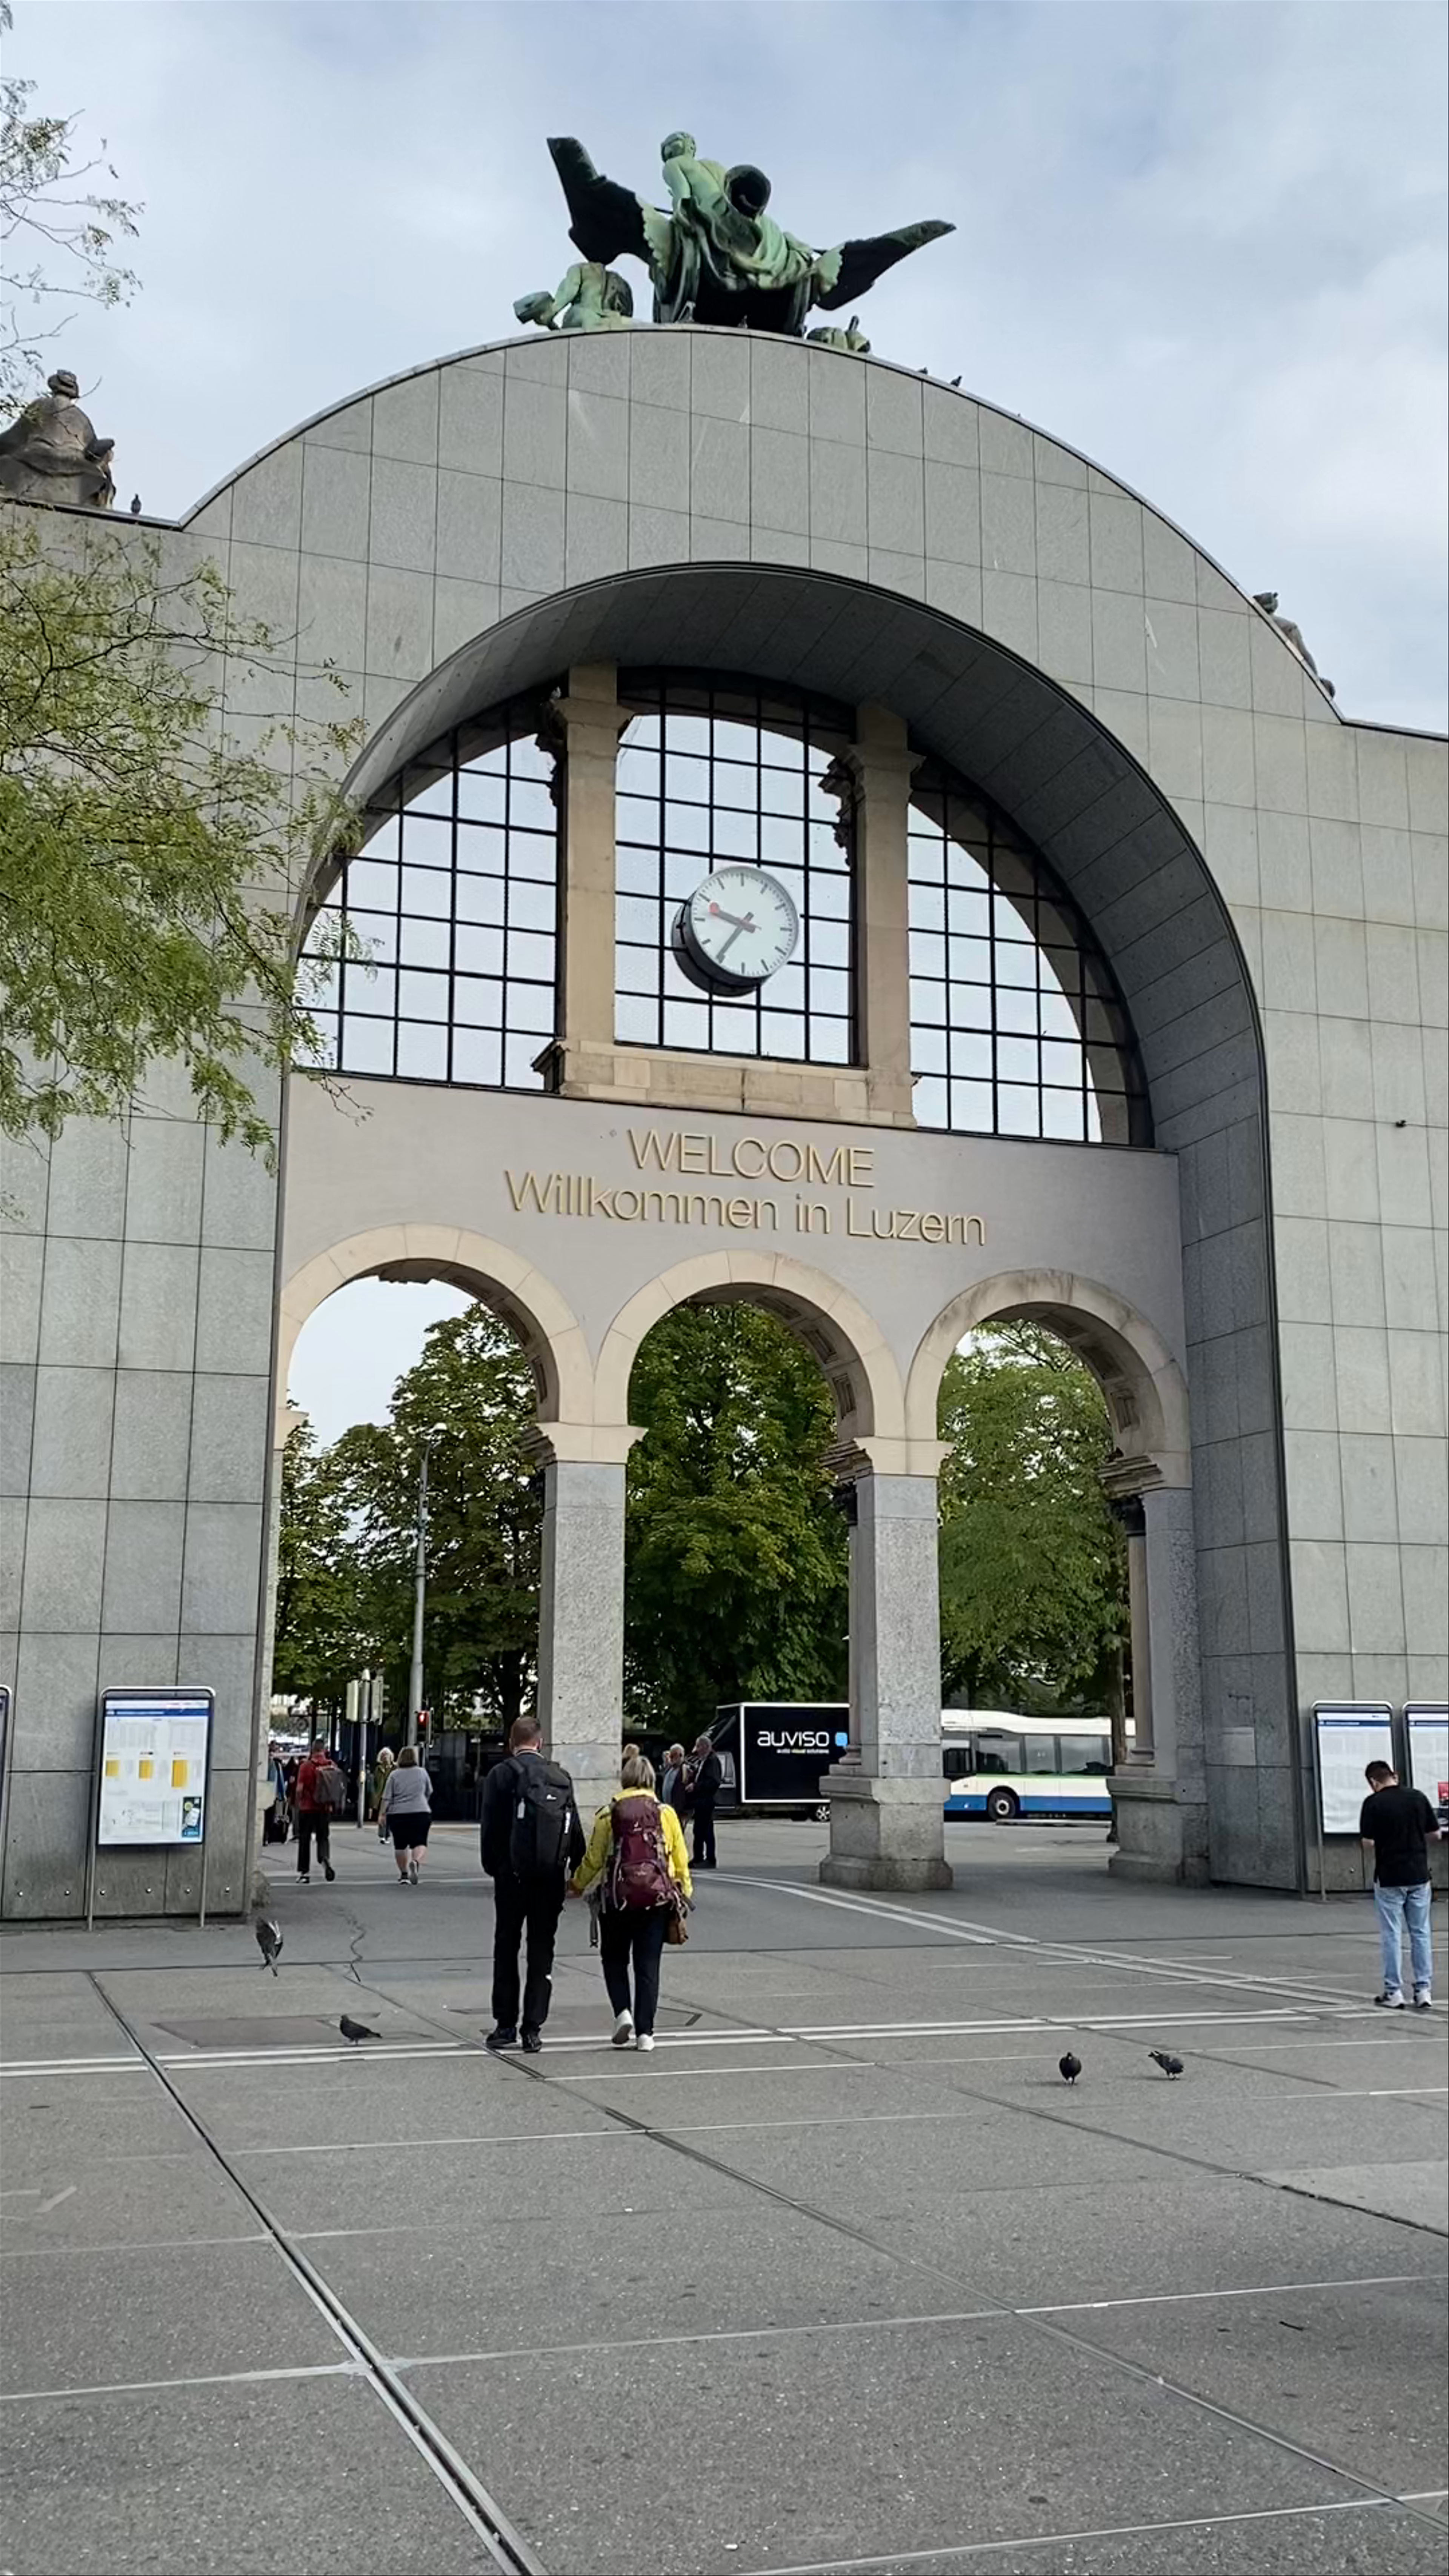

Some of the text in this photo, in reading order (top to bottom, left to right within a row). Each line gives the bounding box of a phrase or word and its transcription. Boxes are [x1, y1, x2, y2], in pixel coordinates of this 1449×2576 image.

[629, 1129, 874, 1187] WELCOME
[505, 1170, 984, 1246] Willkommen in Luzern
